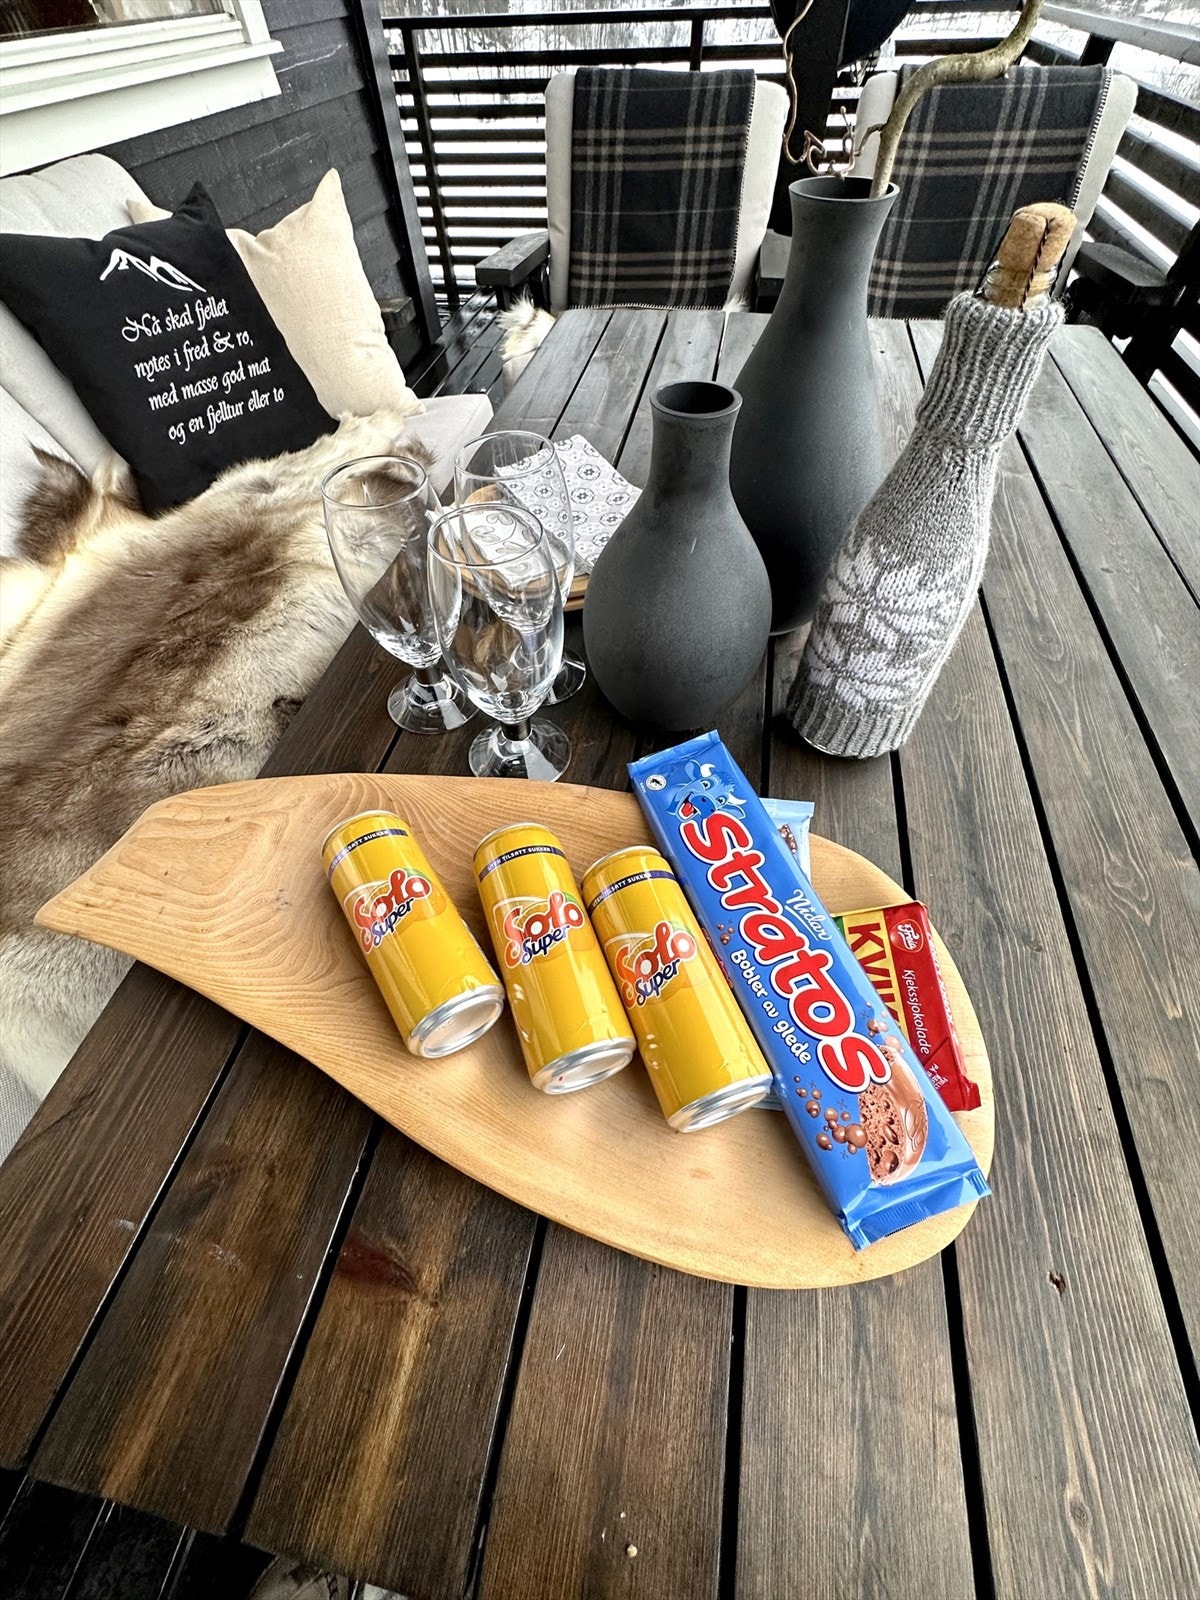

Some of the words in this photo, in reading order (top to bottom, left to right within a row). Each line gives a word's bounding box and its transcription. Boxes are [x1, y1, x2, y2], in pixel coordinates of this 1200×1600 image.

[121, 313, 162, 342] Nå
[165, 303, 194, 331] skal
[195, 296, 229, 331] fjellet
[134, 354, 171, 383] nytes
[173, 348, 181, 366] i
[183, 336, 211, 372] fred
[213, 331, 235, 353] &
[236, 330, 254, 347] ro,
[148, 382, 179, 411] med
[181, 375, 219, 400] masse
[222, 361, 246, 394] god
[248, 357, 271, 378] mat
[168, 423, 185, 445] og
[188, 416, 205, 433] en
[207, 399, 244, 435] fjelltur
[248, 388, 270, 412] eller
[273, 387, 285, 403] to
[353, 868, 432, 955] Solo
[371, 897, 415, 947] Super
[503, 889, 585, 969] Solo
[785, 889, 833, 941] Nidar
[897, 923, 920, 950] Freia
[520, 924, 571, 966] Super
[615, 920, 698, 1008] Solo
[678, 808, 892, 1094] Stratos
[635, 958, 681, 1006] Super
[731, 949, 769, 998] Bobler
[762, 999, 779, 1019] av
[772, 1019, 812, 1065] glede
[901, 969, 930, 1055] Kjekssjokolade
